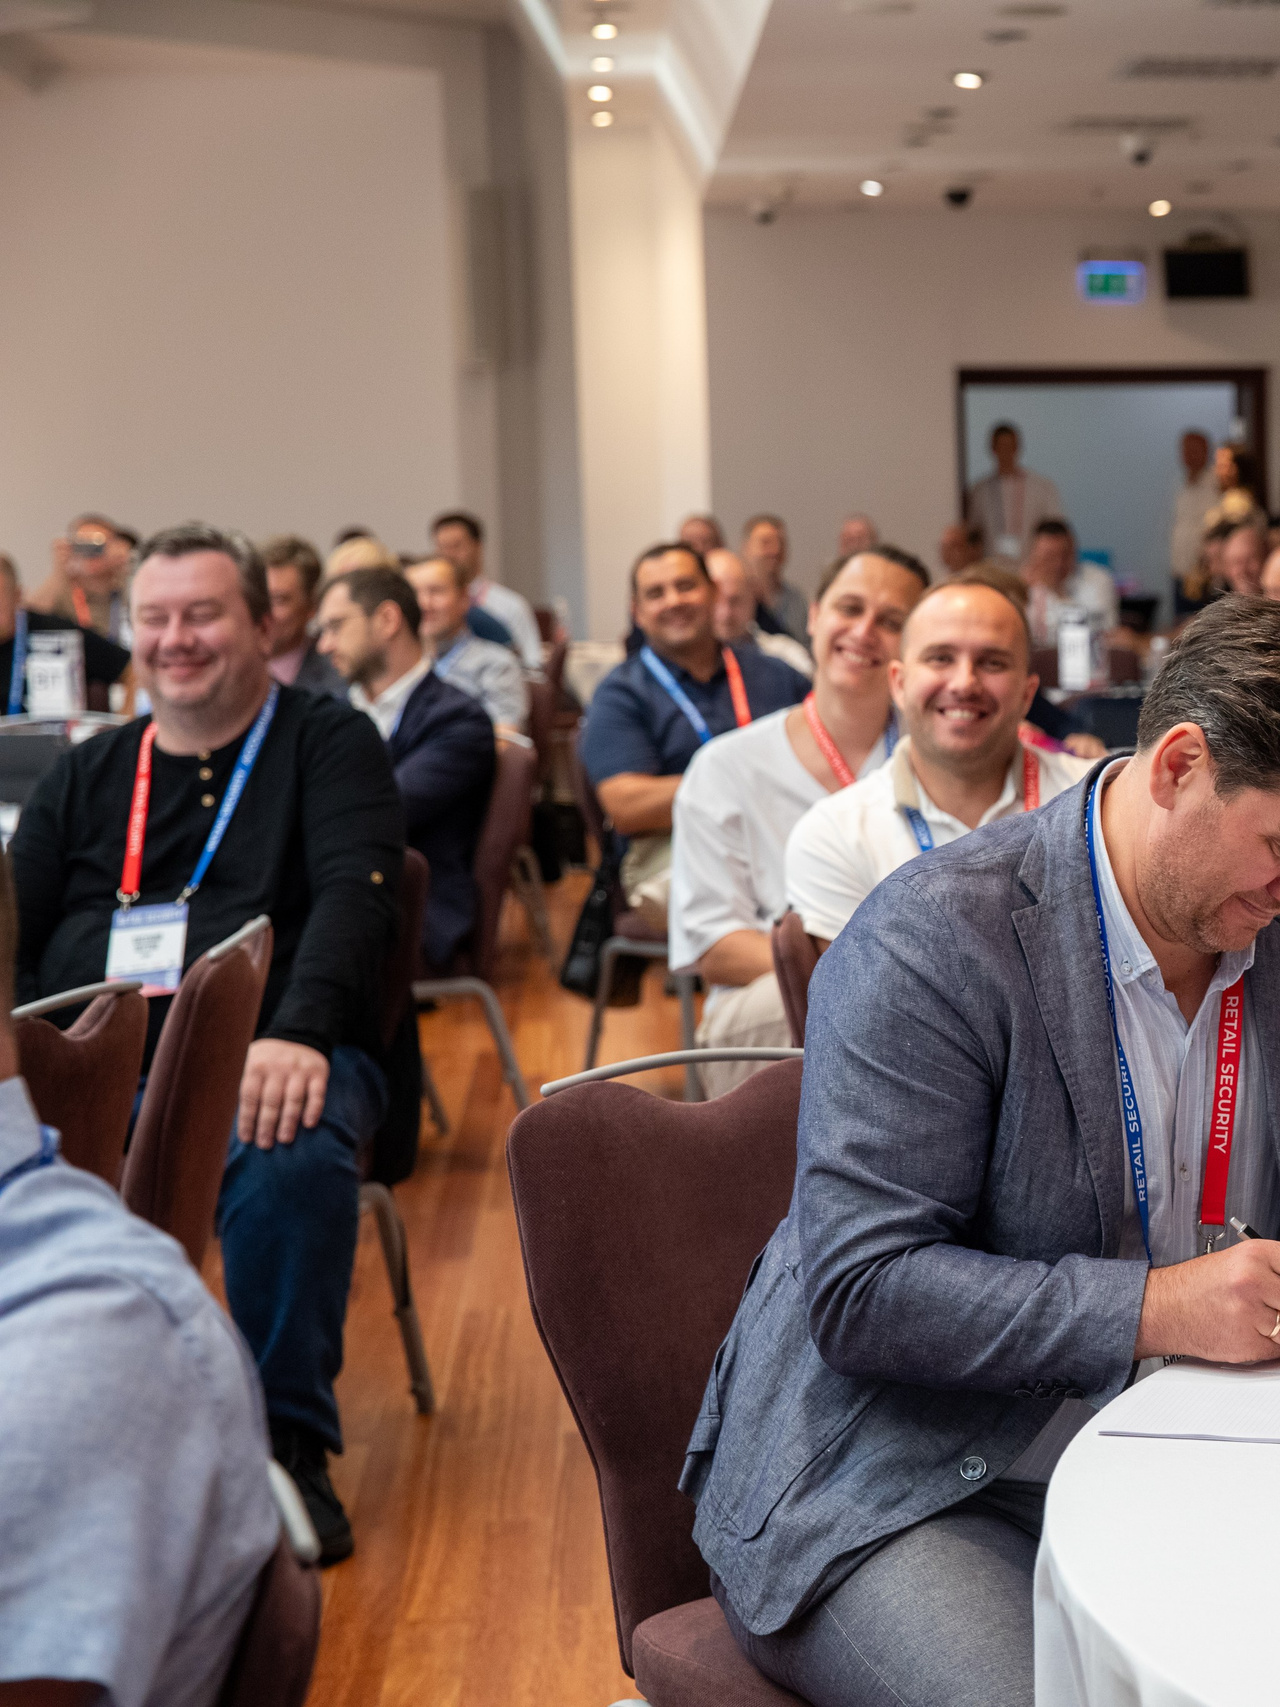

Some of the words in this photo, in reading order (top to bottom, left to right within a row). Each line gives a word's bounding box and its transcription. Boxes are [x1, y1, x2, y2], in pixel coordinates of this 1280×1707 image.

[1222, 996, 1239, 1058] RETAIL
[1213, 1063, 1235, 1155] SECURITY
[1132, 1137, 1147, 1202] RETAIL
